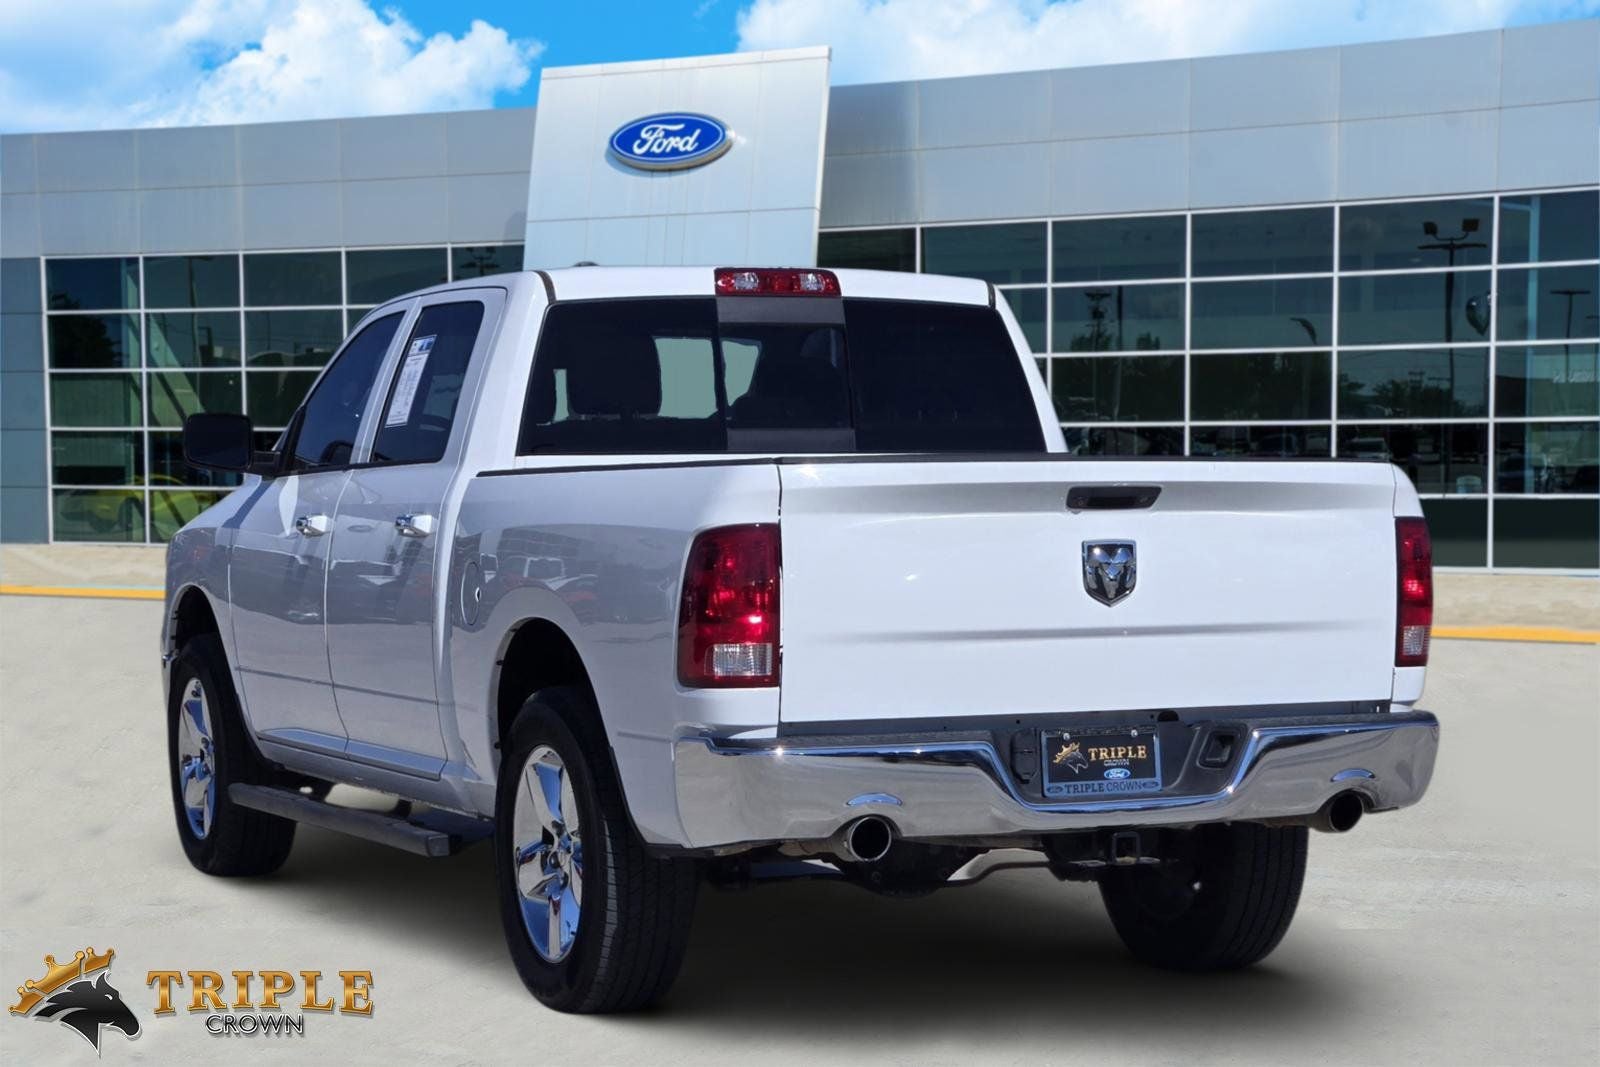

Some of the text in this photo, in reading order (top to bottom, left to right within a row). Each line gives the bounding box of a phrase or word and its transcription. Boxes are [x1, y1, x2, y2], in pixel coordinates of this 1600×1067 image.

[632, 123, 701, 154] Ford
[1088, 746, 1147, 760] TRIPLE
[1065, 784, 1103, 794] TRIPLE
[1106, 781, 1142, 791] CROWN
